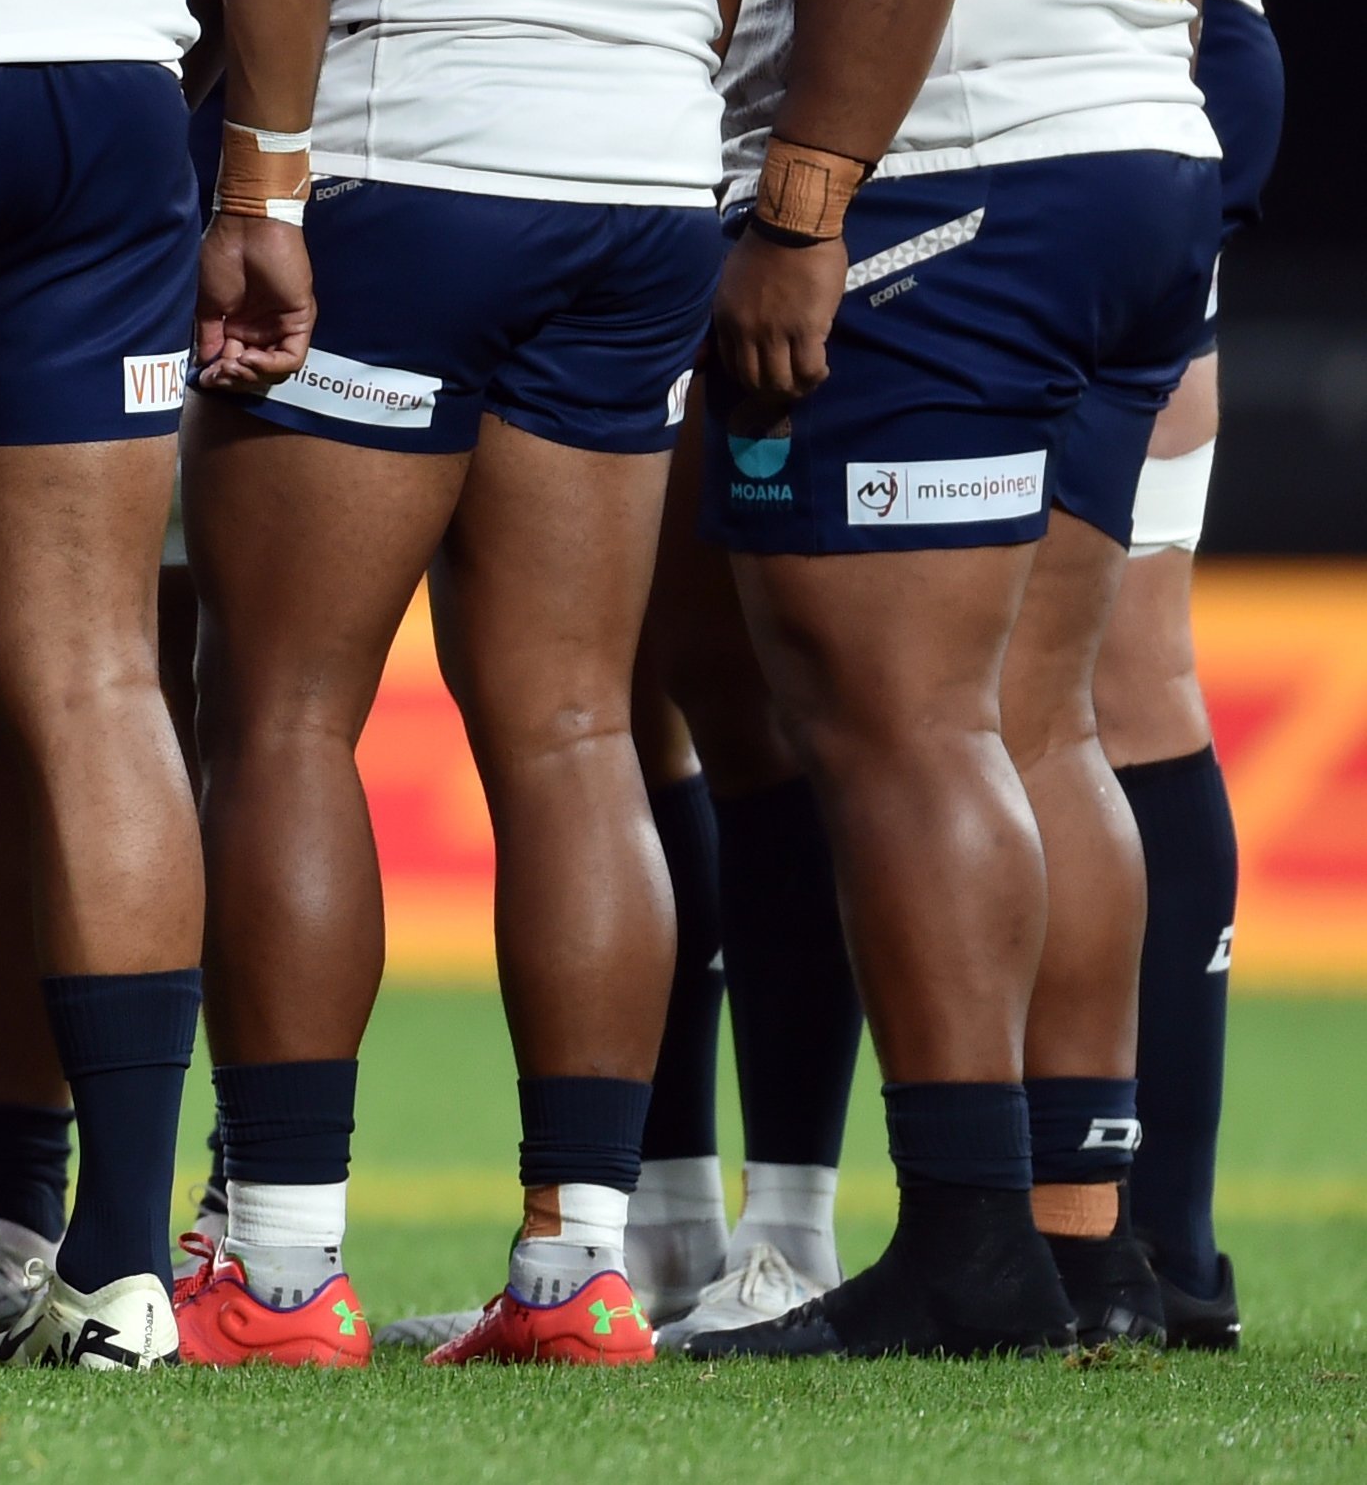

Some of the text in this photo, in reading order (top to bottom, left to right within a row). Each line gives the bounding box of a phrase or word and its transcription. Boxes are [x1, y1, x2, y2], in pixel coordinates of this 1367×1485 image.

[869, 273, 919, 308] ECOTEK
[289, 364, 424, 412] iscojoinery
[730, 482, 794, 503] MOANA
[917, 472, 1038, 501] miscojoinery
